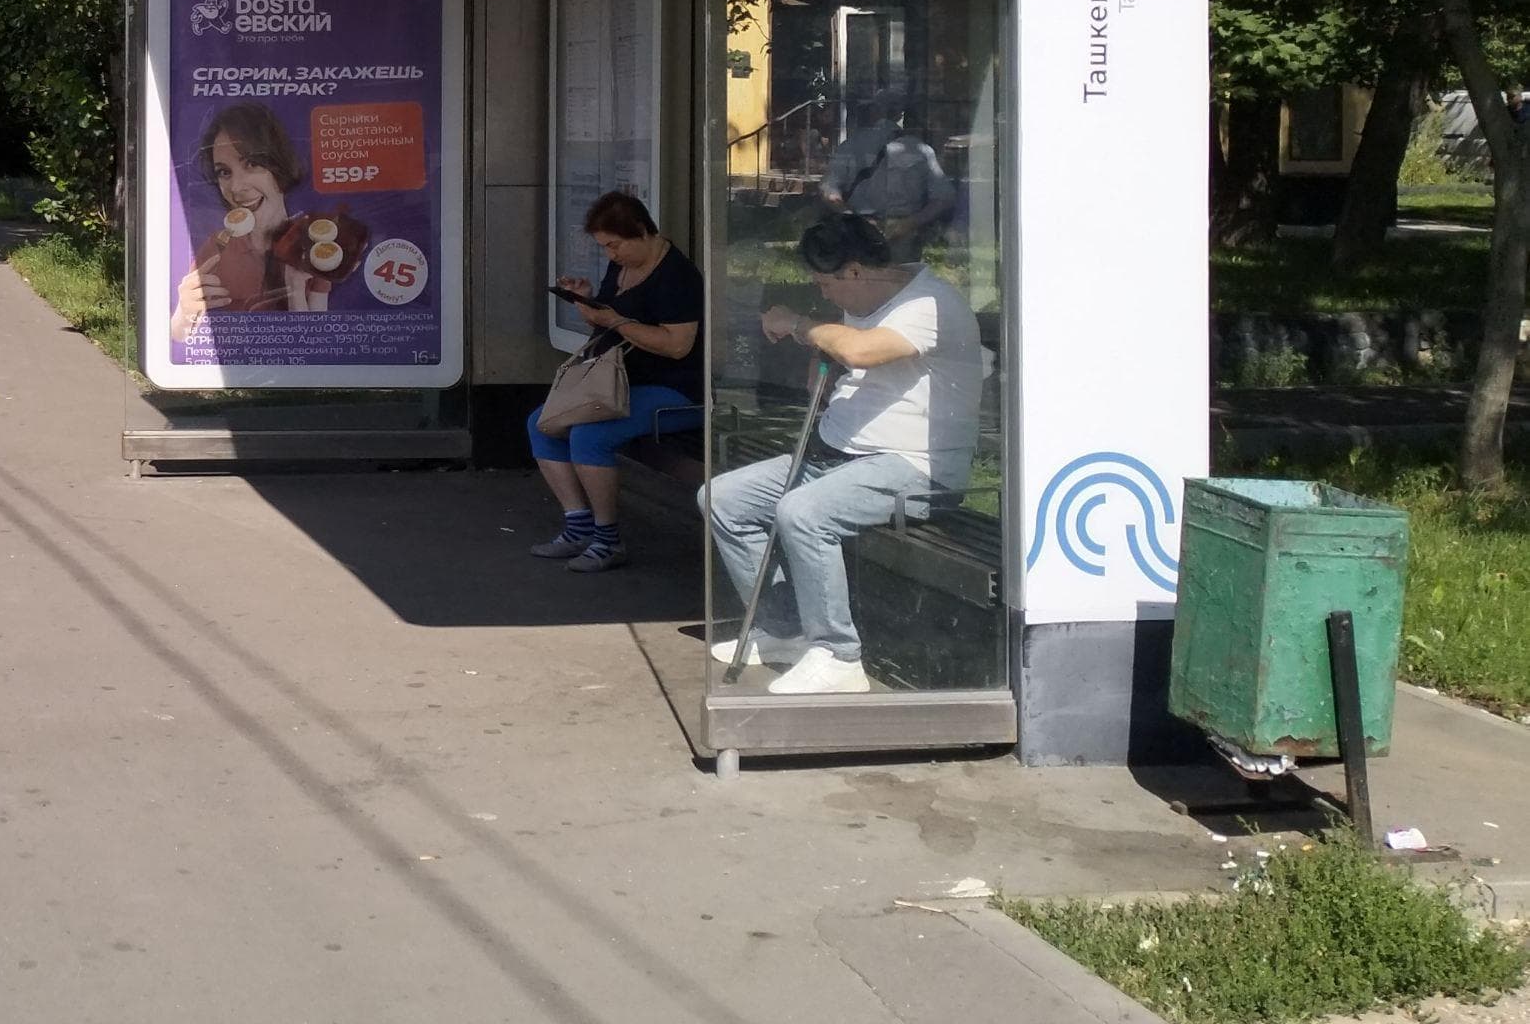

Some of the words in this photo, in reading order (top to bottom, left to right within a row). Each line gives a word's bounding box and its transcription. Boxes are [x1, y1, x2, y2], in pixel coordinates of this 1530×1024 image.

[192, 67, 292, 82] СПОРИМ,
[294, 65, 425, 81] ЗАКАЖЕШЬ
[192, 83, 224, 97] НА
[226, 82, 338, 96] ЗАВТРАК?
[319, 113, 380, 127] Сырники
[320, 127, 336, 137] со
[320, 139, 330, 149] и
[332, 136, 415, 151] брусничным
[320, 150, 370, 163] соусом
[373, 259, 417, 287] 45
[184, 335, 215, 346] ОГРН
[412, 350, 439, 364] 16+
